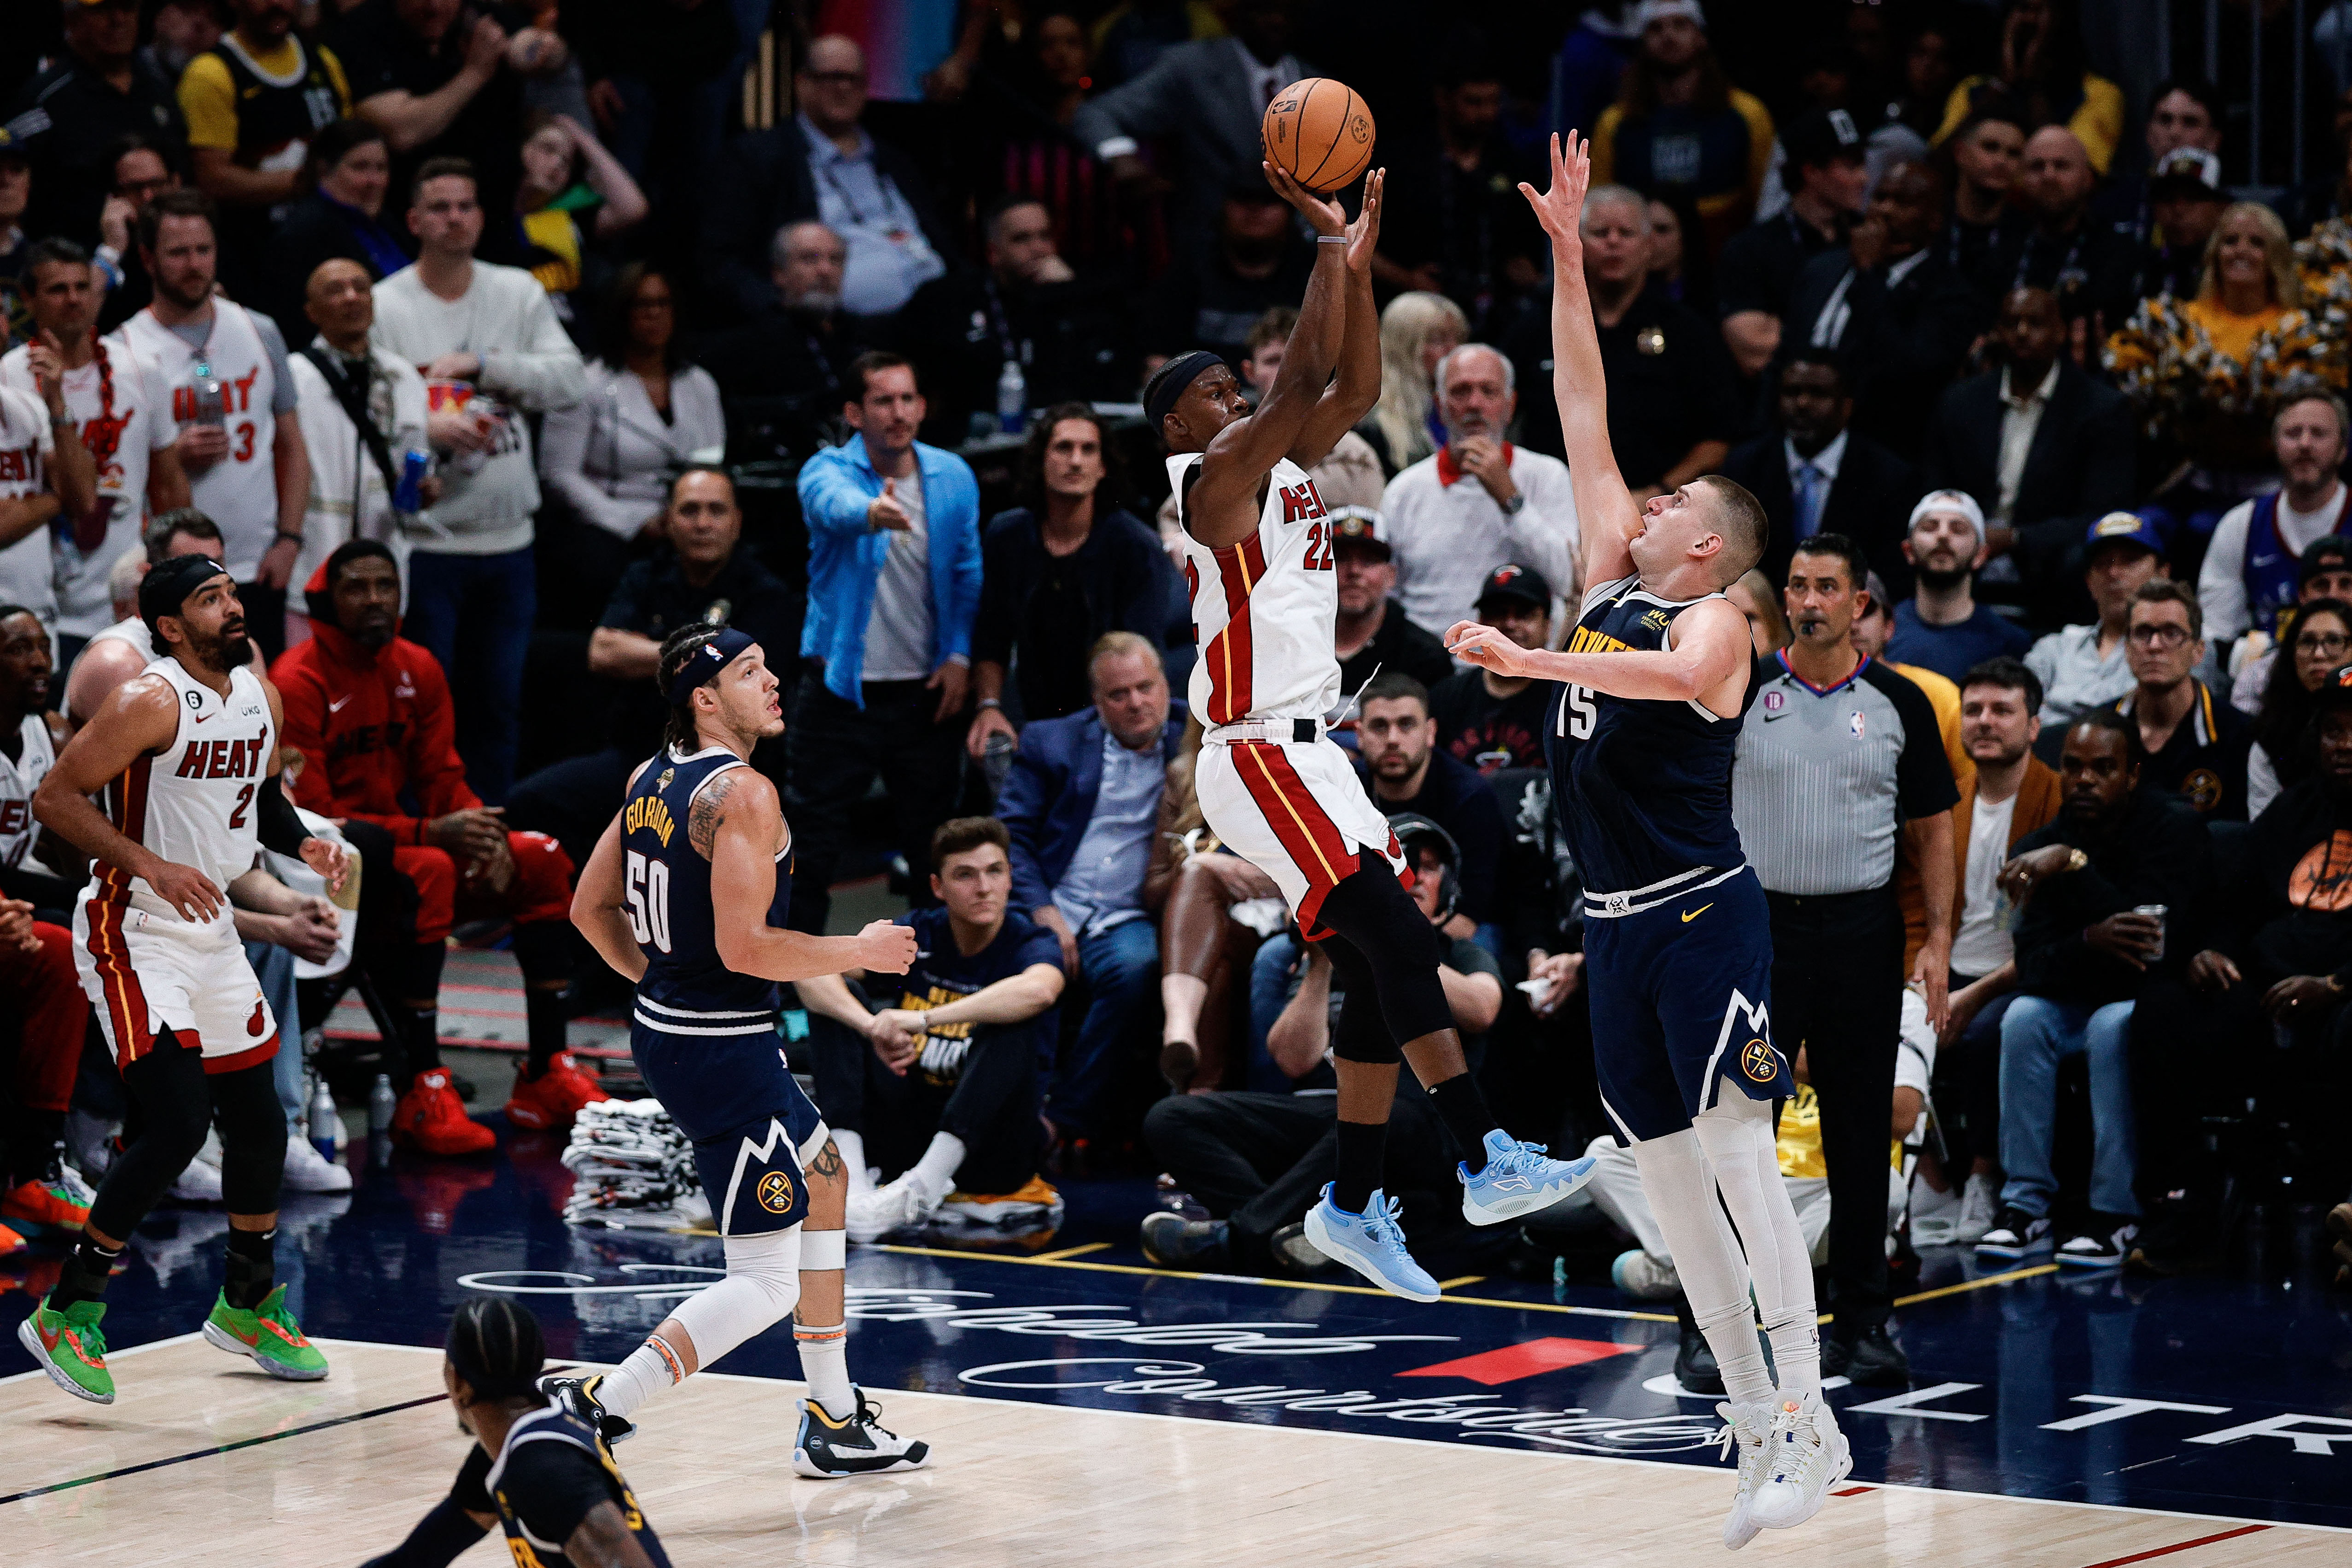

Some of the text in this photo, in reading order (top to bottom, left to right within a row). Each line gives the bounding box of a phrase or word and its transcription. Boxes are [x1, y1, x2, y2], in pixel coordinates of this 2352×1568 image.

[1303, 523, 1333, 571] 22
[1640, 619, 1656, 631] Union
[1641, 615, 1662, 631] Western
[1647, 609, 1669, 626] WU
[189, 692, 199, 708] 6
[241, 706, 261, 716] UKG
[1556, 682, 1597, 740] 15
[174, 722, 268, 779] HEAT
[229, 783, 255, 830] 2
[626, 796, 676, 849] GORDON
[626, 847, 672, 955] 50
[957, 1357, 1722, 1454] Courtside
